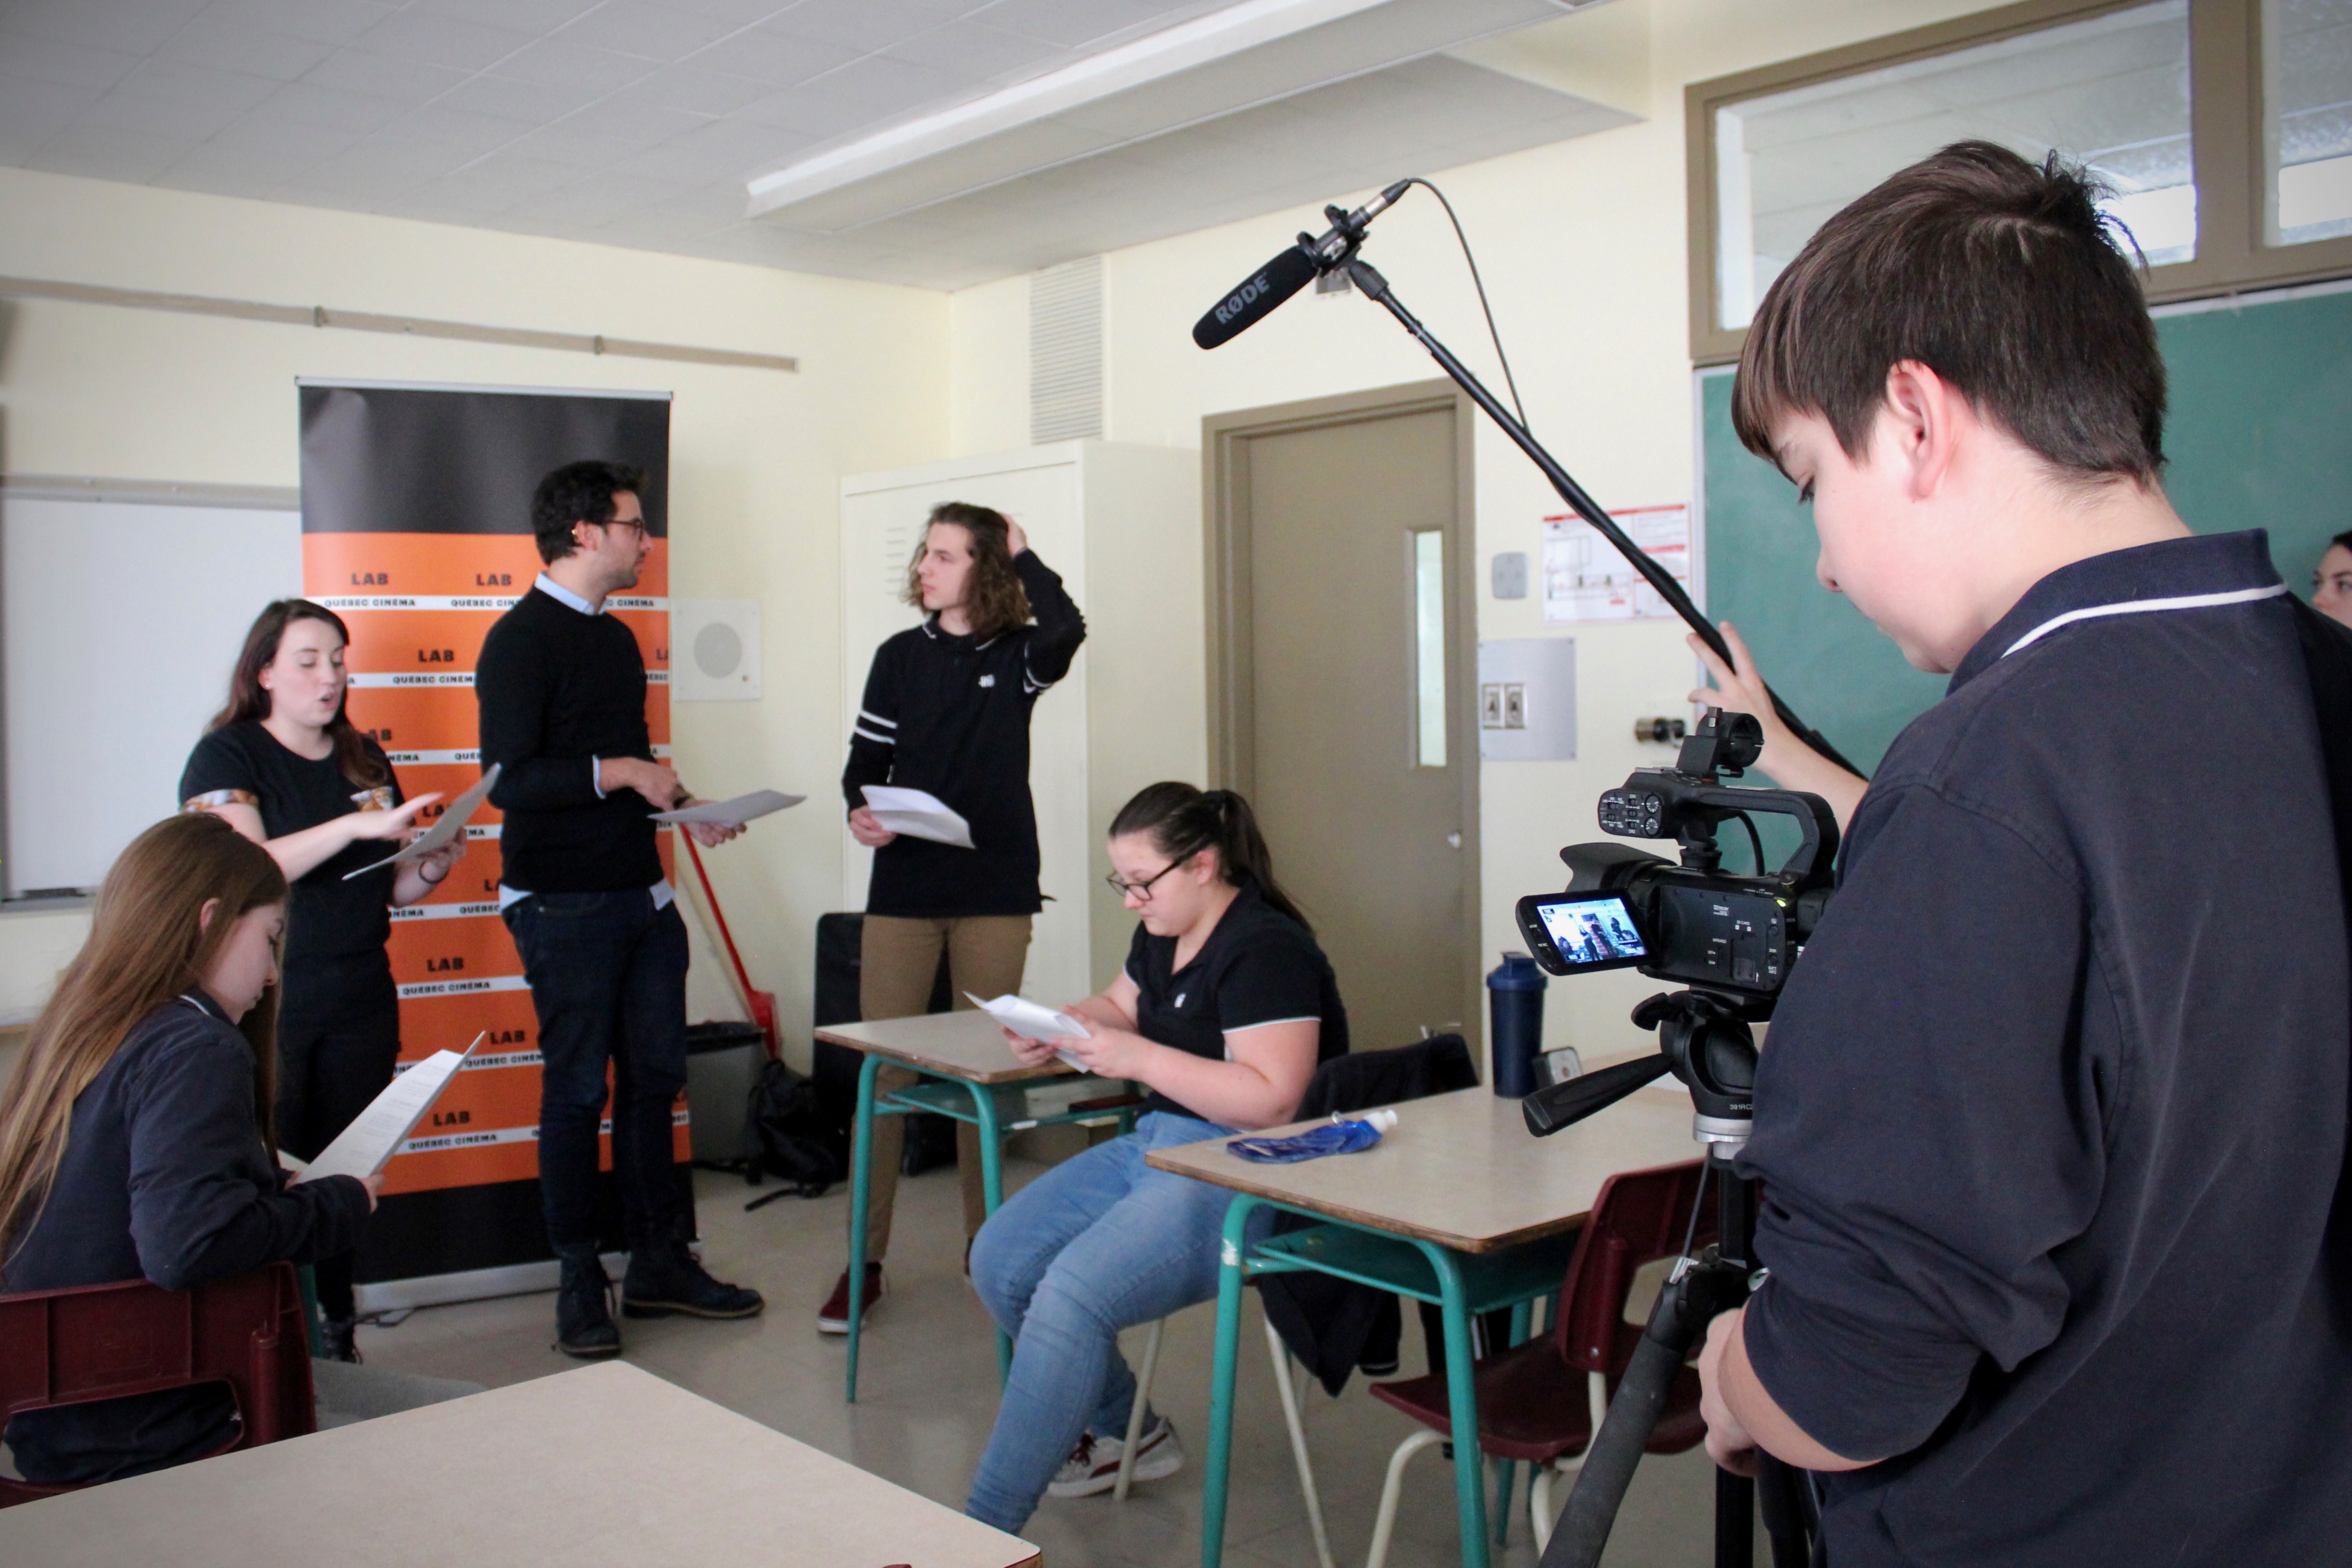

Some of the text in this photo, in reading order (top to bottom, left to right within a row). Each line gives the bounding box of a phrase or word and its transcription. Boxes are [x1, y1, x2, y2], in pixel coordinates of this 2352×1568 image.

[1215, 275, 1271, 324] RØDE
[351, 572, 388, 586] LAB
[475, 573, 512, 586] LAB
[496, 599, 516, 607] CIN
[418, 650, 454, 662] LAB
[426, 957, 463, 972] LAB
[489, 1030, 525, 1045] LAB
[433, 1111, 470, 1127] LAB
